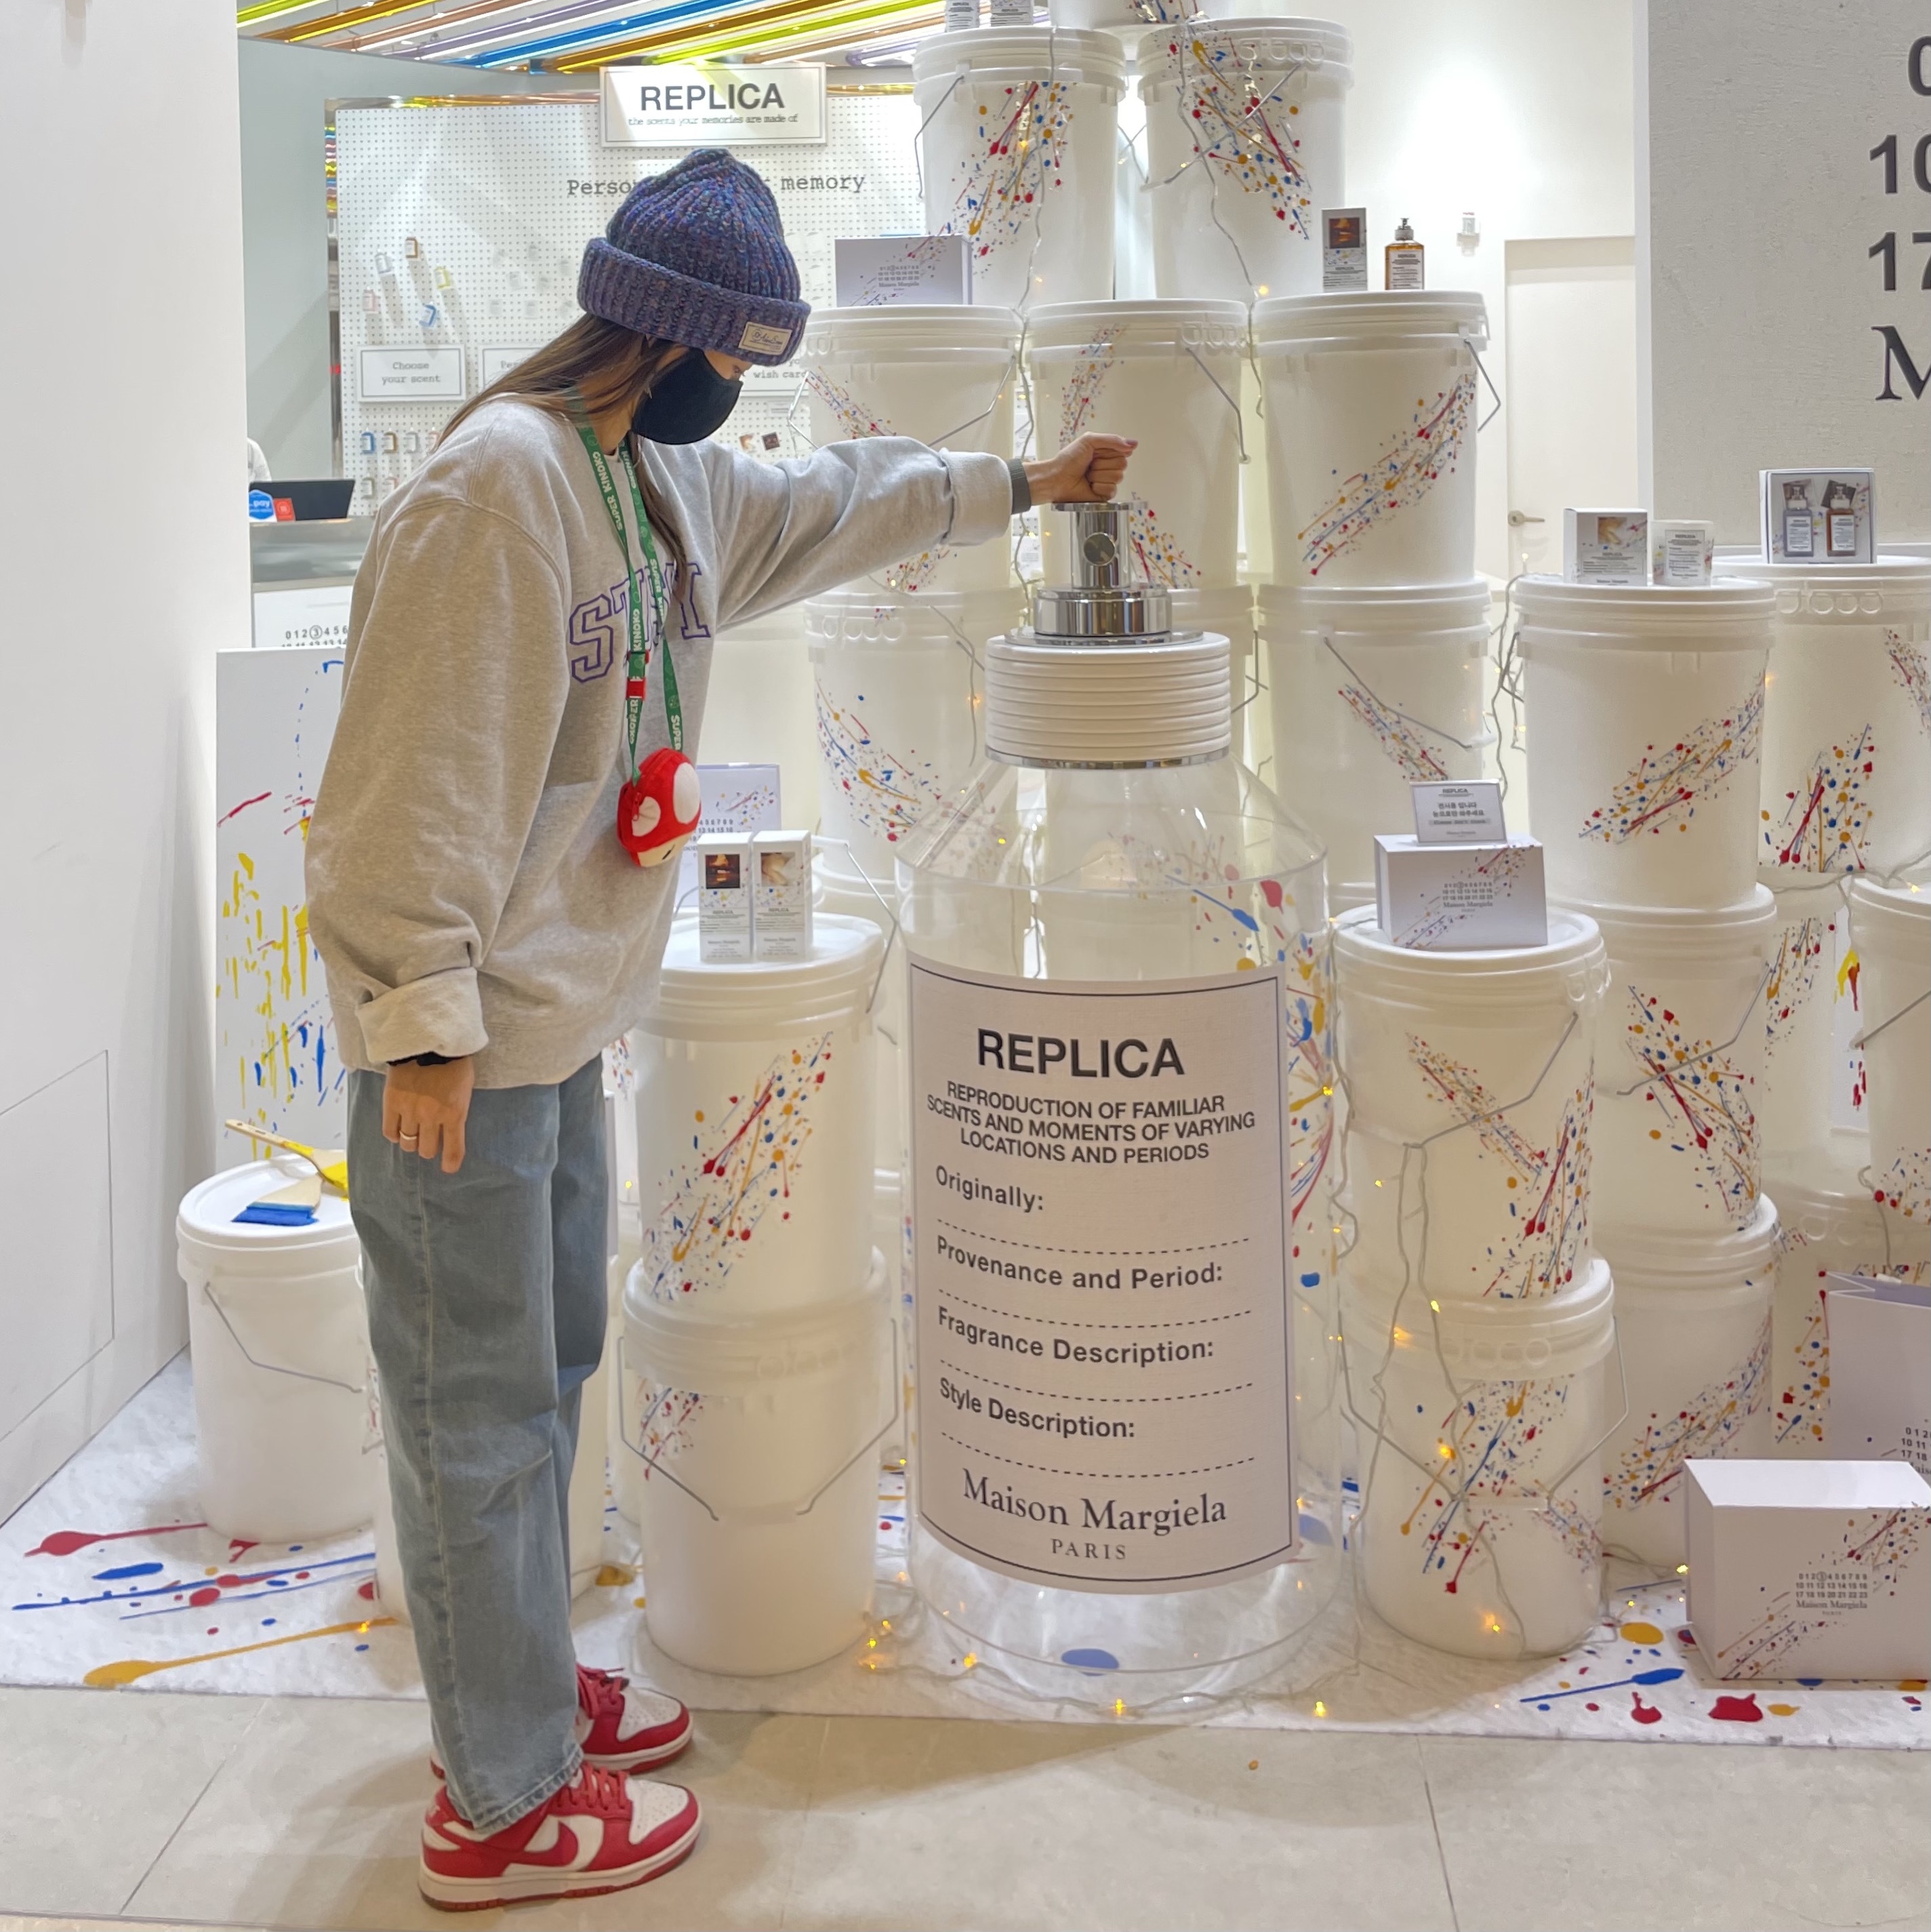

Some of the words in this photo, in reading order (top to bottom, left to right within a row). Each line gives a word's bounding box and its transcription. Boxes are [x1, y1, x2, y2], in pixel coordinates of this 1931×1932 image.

[641, 83, 786, 111] REPLICA
[788, 114, 798, 122] of
[567, 179, 634, 196] Perso
[780, 176, 866, 195] memory
[382, 376, 407, 386] your
[411, 375, 441, 383] scent
[392, 361, 429, 369] Choose
[753, 370, 779, 378] wish
[592, 451, 612, 493] KINOKO
[607, 495, 623, 531] SUPER
[649, 559, 661, 593] SUPER
[286, 630, 291, 639] 0
[294, 630, 298, 638] 1
[302, 629, 307, 638] 2
[632, 608, 643, 651] KINOKO
[977, 1028, 1185, 1078] REPLICA
[948, 1081, 1092, 1119] REPRODUCTION
[1099, 1102, 1126, 1119] OF
[1133, 1095, 1225, 1119] FAMILIAR
[927, 1094, 981, 1126] SCENTS
[985, 1113, 1023, 1134] AND
[1029, 1119, 1136, 1142] MOMENTS
[1142, 1123, 1169, 1141] OF
[1175, 1111, 1255, 1139] VARYING
[960, 1127, 1065, 1161] LOCATIONS
[1072, 1146, 1117, 1163] AND
[1124, 1143, 1209, 1163] PERIODS
[936, 1165, 1043, 1213] Originally:
[937, 1234, 1062, 1286] Provenance
[1072, 1268, 1120, 1289] and
[1132, 1262, 1221, 1289] Period:
[938, 1305, 1043, 1356] Fragrance
[1054, 1338, 1213, 1367] Description:
[940, 1377, 981, 1413] Style
[988, 1398, 1134, 1438] Description:
[1902, 1438, 1912, 1446] 10
[1917, 1441, 1925, 1449] 11
[1915, 1428, 1919, 1436] 1
[1902, 1450, 1911, 1458] 17
[962, 1468, 1070, 1526] Maison
[1080, 1493, 1226, 1536] Margiela
[1051, 1538, 1126, 1559] PARIS
